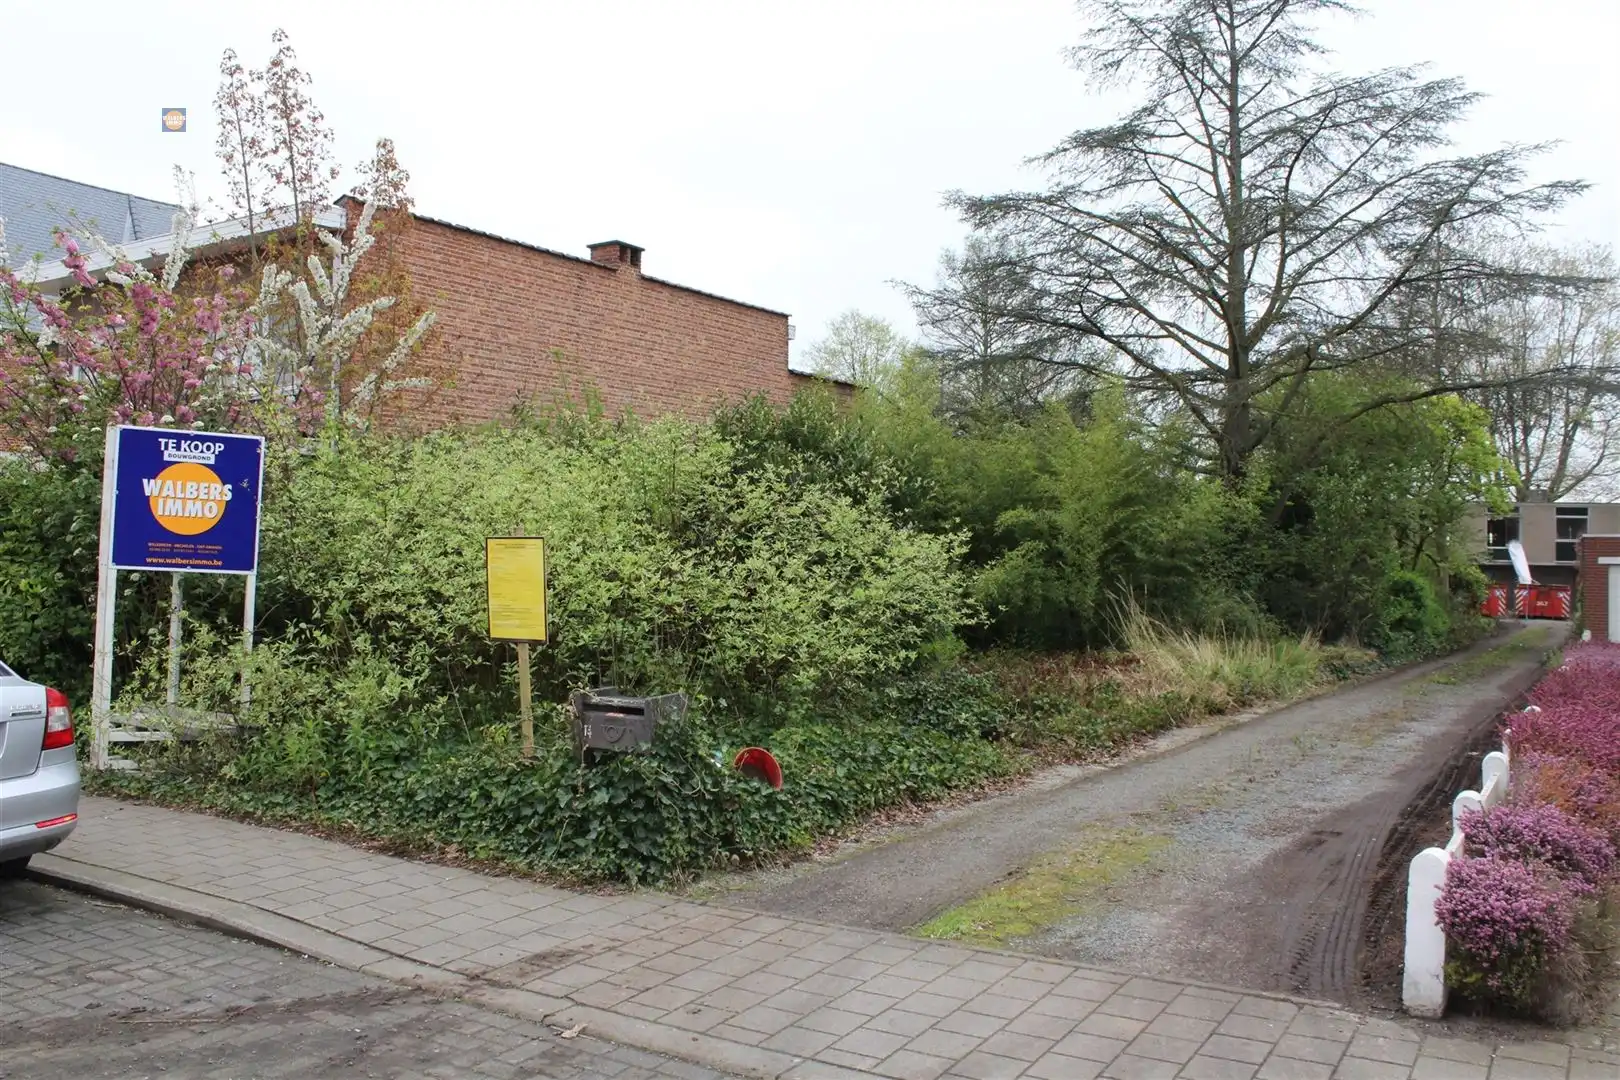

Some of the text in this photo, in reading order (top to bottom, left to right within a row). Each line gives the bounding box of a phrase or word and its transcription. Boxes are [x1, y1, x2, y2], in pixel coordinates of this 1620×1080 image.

[158, 438, 225, 455] TE KOOP
[167, 452, 212, 461] BOUWGROND
[142, 478, 233, 501] WALBERS
[157, 498, 218, 518] IMMO
[145, 556, 223, 566] www.walbersimmo.be
